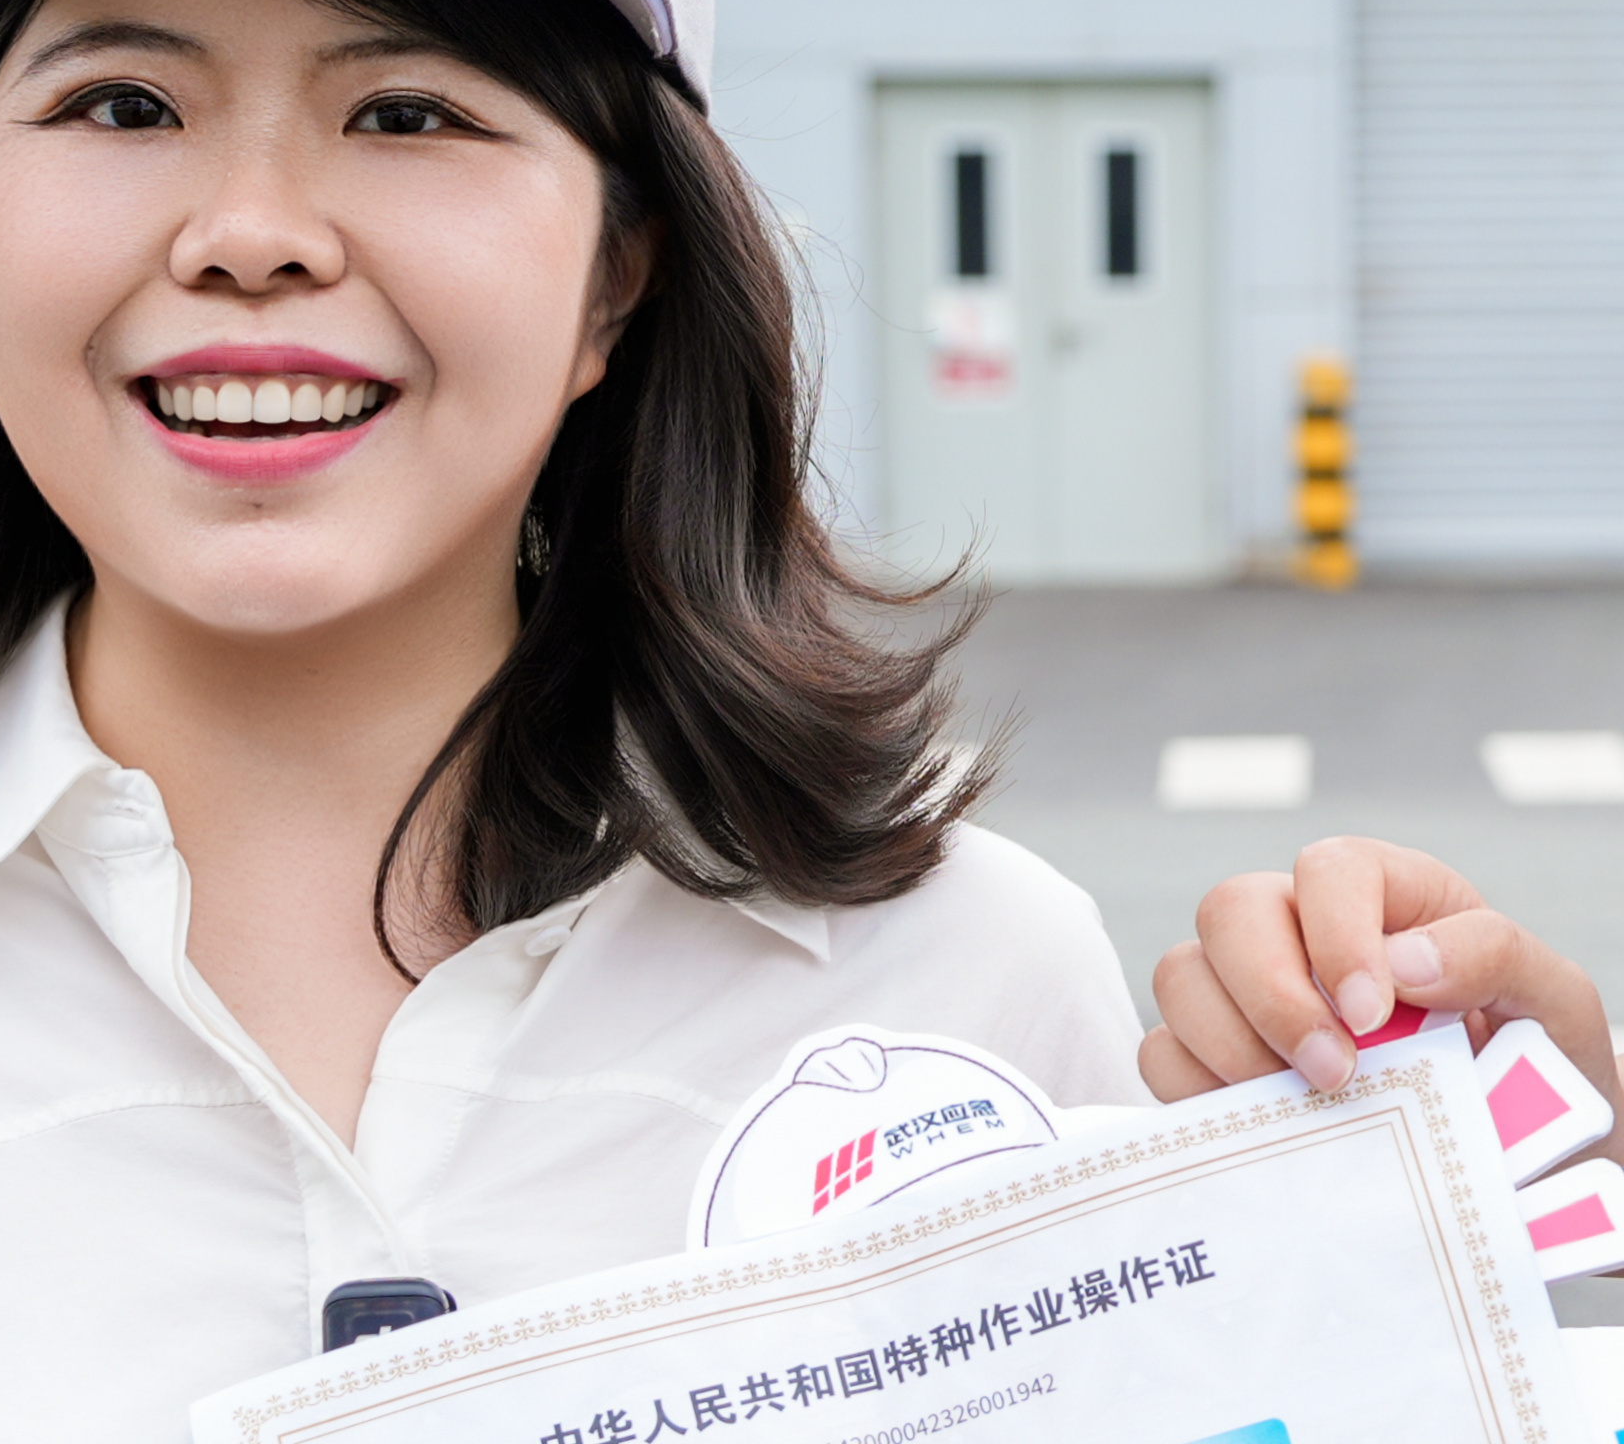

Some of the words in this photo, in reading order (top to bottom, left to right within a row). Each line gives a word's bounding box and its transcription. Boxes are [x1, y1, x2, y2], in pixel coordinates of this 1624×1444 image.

[883, 1099, 1000, 1148] 武汉应急
[890, 1119, 1006, 1159] WHEM
